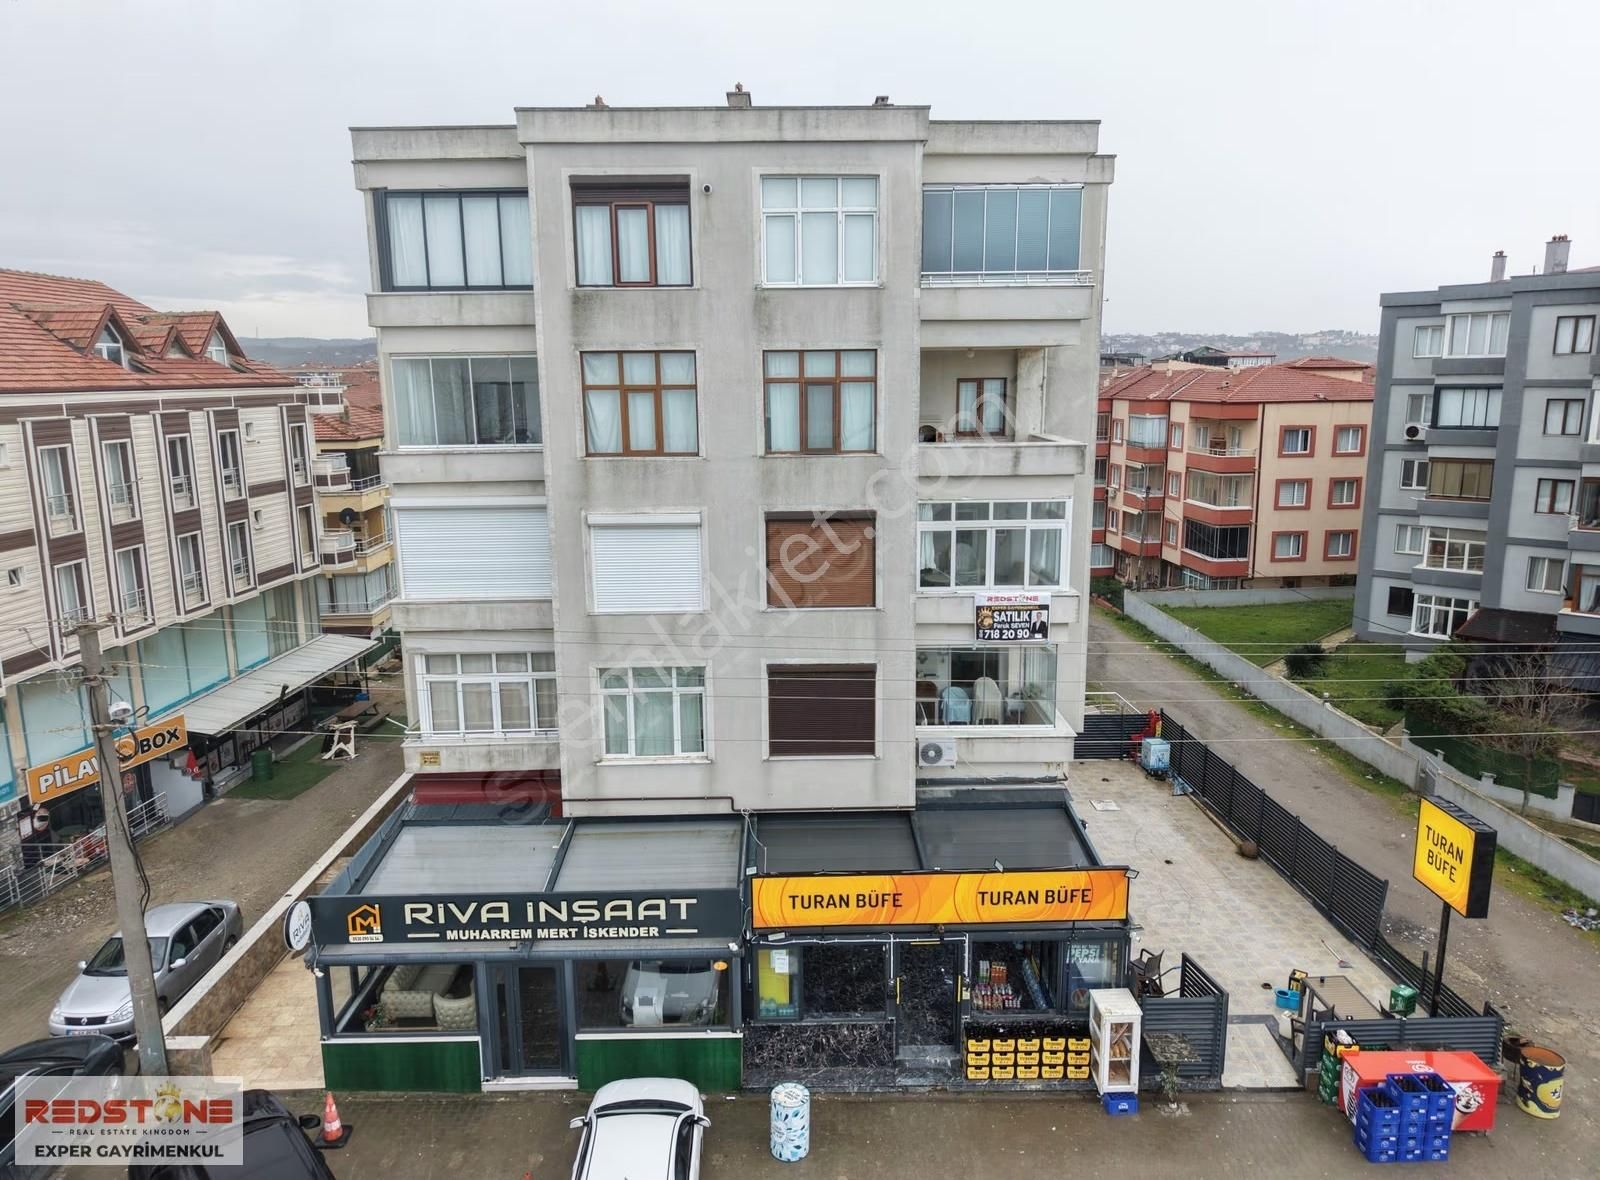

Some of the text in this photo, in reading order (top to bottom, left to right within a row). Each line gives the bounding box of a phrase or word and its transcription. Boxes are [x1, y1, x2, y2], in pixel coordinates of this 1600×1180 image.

[993, 610, 1031, 622] SATILIK
[984, 630, 1000, 639] 718
[1002, 630, 1015, 639] 20
[1017, 629, 1030, 638] 90
[39, 727, 181, 795] PİLA BOX
[1425, 825, 1464, 865] TURAN
[1427, 849, 1457, 883] BÜFE
[788, 884, 1092, 910] TURAN BÜFE TURAN BÜFE
[446, 924, 660, 941] MUHARREM MERT İSKENDER
